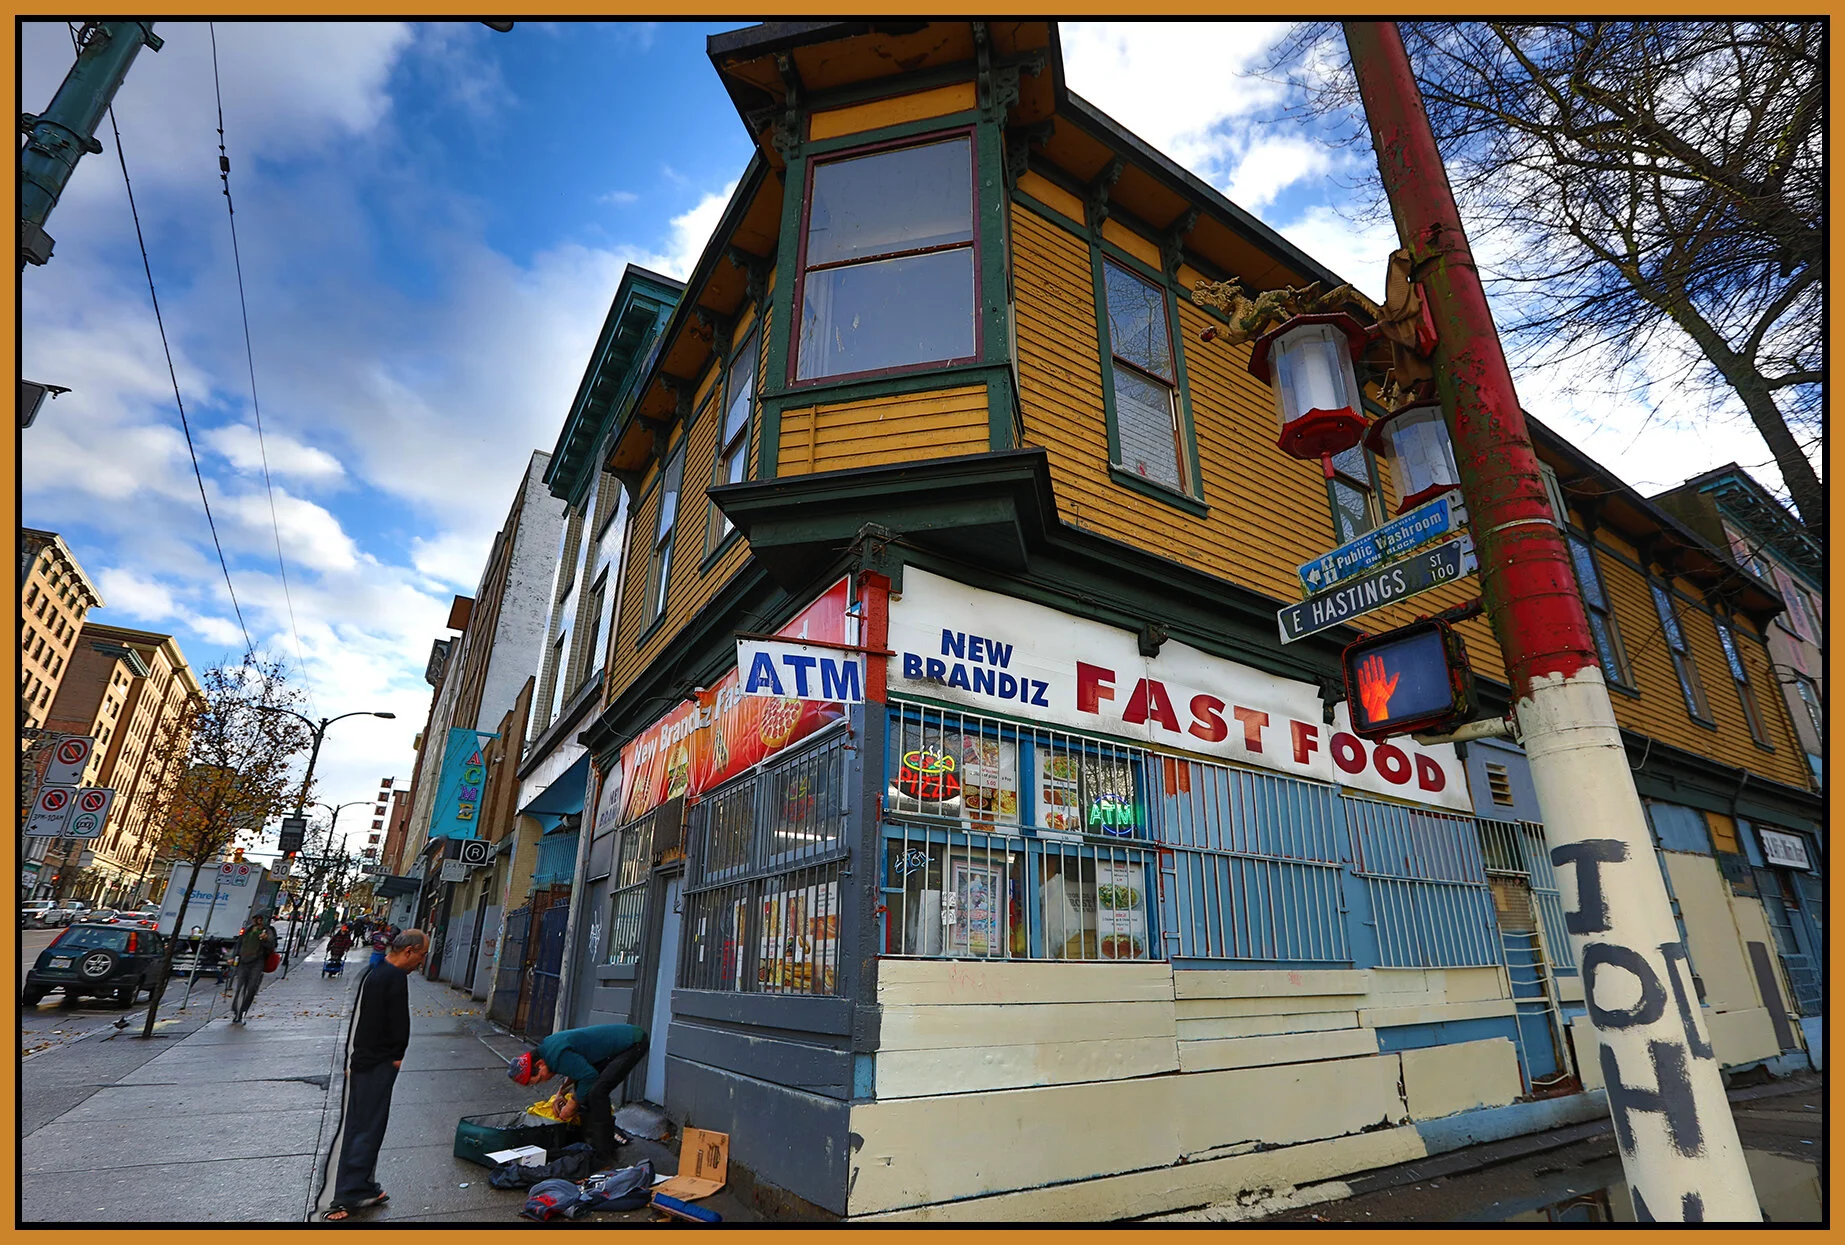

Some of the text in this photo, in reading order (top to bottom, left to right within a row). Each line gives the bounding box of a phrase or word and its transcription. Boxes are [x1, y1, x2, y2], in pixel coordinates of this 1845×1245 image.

[1336, 512, 1442, 569] Public Washroom
[1353, 537, 1372, 547] CLEAN
[1365, 538, 1416, 564] ONE BLOCK
[1429, 553, 1443, 568] ST
[1292, 563, 1454, 632] E HASTINGS 100
[940, 628, 1013, 668] NEW
[745, 652, 860, 702] ATM
[903, 652, 1049, 708] BRANDIZ
[634, 682, 747, 768] New Brandiz Fas
[1076, 660, 1446, 793] FAST FOOD
[456, 751, 483, 821] ACME
[896, 766, 960, 799] PIZZA
[1089, 803, 1132, 826] ATM
[272, 865, 288, 875] 30
